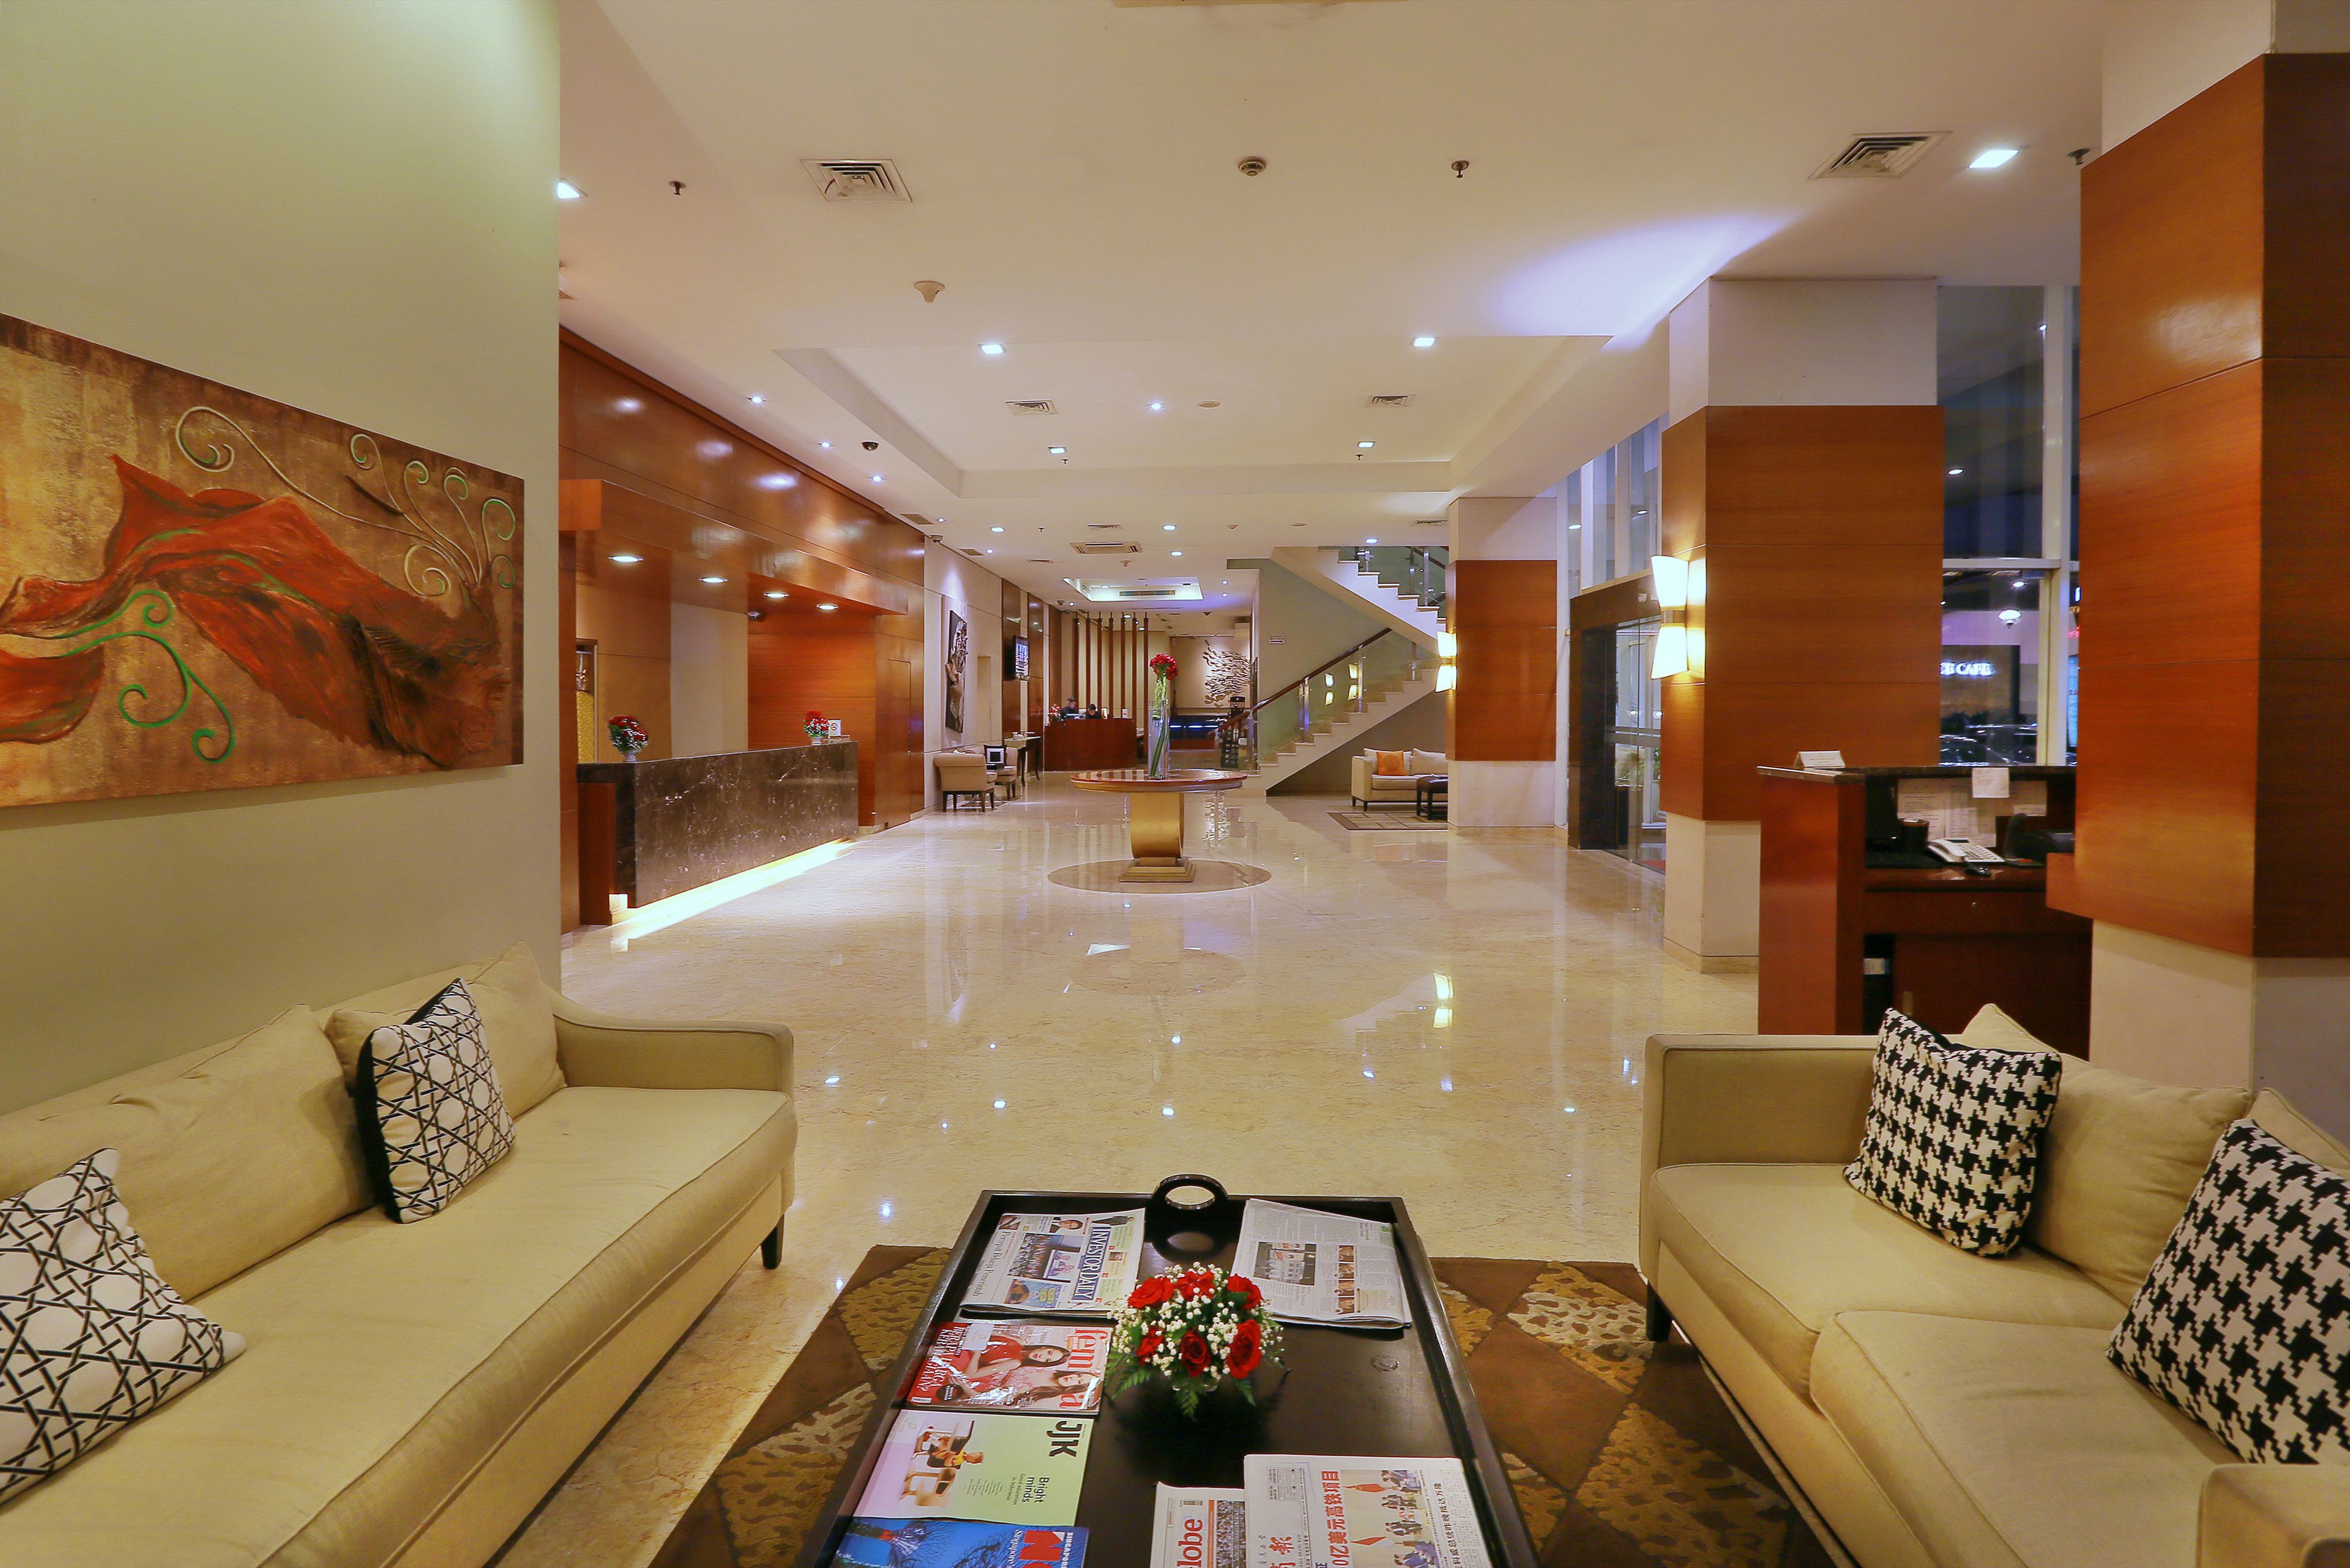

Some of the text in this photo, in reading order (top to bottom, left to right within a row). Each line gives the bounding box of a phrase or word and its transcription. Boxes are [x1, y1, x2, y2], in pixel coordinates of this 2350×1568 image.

[1074, 1228, 1111, 1299] INVESTOR DAILY
[943, 1326, 966, 1355] BERAPA
[1059, 1328, 1108, 1409] fema
[1046, 1421, 1083, 1457] JJK
[1006, 1481, 1016, 1501] Indonesia
[1013, 1485, 1022, 1505] education
[1022, 1477, 1035, 1503] minds
[1034, 1477, 1050, 1503] Bright
[1321, 1471, 1350, 1568] 0亿美元高铁项目
[1177, 1519, 1203, 1568] lobe
